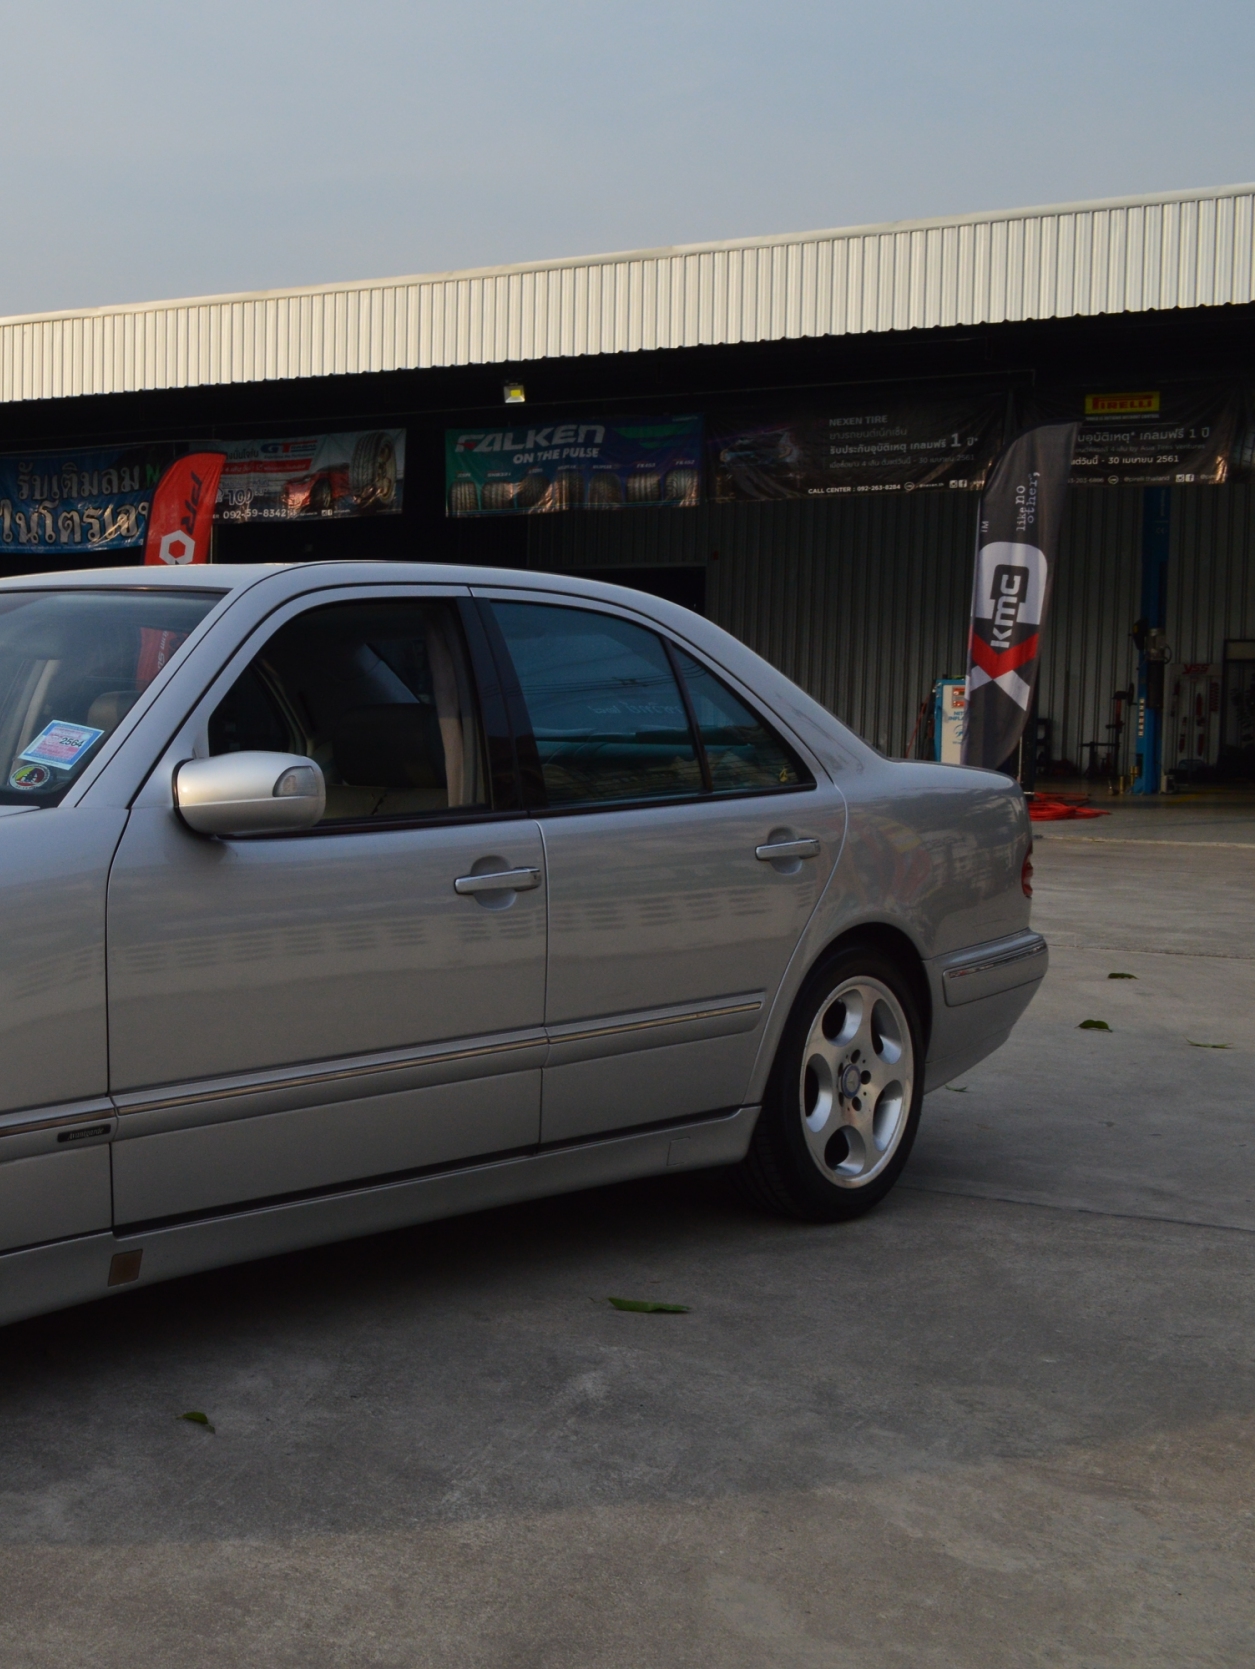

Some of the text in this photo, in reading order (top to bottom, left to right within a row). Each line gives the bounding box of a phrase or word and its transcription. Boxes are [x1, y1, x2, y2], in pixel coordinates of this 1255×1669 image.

[1092, 395, 1153, 411] PIRELLI
[829, 415, 888, 427] NEXEN TIRE
[454, 424, 605, 453] FALKEN
[950, 433, 962, 448] 1
[1189, 429, 1196, 438] 1
[513, 447, 600, 464] ON THE PULSE
[1107, 456, 1120, 465] 30
[1156, 454, 1180, 463] 2561
[17, 461, 141, 500] รับเติมลม
[826, 486, 851, 494] CENTER
[1015, 486, 1027, 531] like no
[59, 737, 85, 748] 2564
[67, 1127, 104, 1141] Avantgarde
